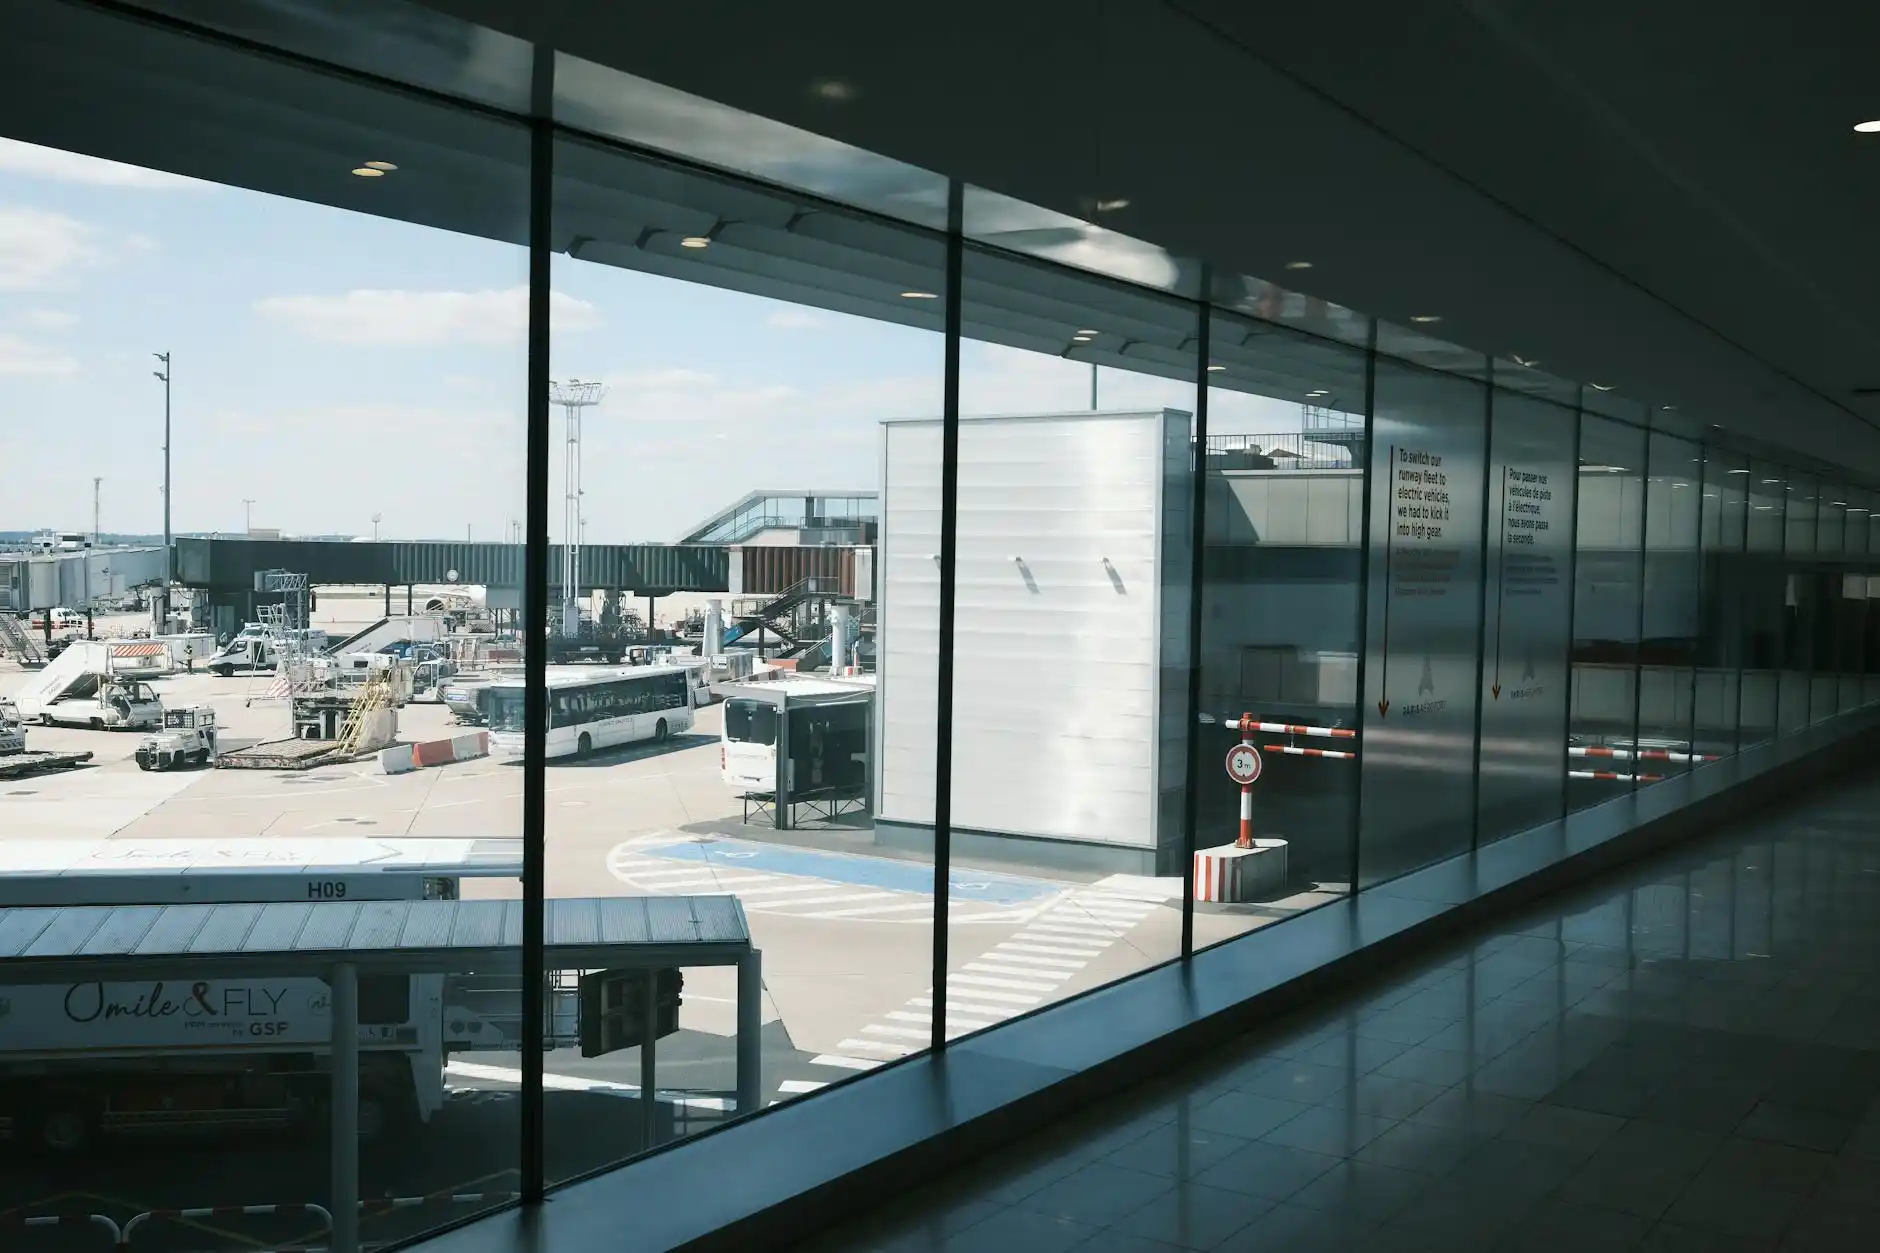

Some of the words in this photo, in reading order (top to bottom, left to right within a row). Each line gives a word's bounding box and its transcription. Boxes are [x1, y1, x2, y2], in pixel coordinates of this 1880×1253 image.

[1399, 448, 1408, 462] To
[1409, 450, 1429, 466] switch
[1431, 456, 1442, 467] our
[1399, 469, 1421, 485] runway
[1424, 469, 1438, 484] fleet
[1440, 473, 1446, 485] to
[1509, 468, 1521, 481] Pour
[1398, 486, 1422, 501] electric
[1424, 488, 1449, 506] vehicles,
[1533, 487, 1539, 499] de
[1398, 505, 1407, 517] we
[1409, 504, 1420, 518] had
[1422, 506, 1429, 519] to
[1431, 506, 1442, 520] kick
[1445, 506, 1449, 520] it
[1397, 522, 1410, 536] into
[1412, 522, 1425, 539] high
[1427, 527, 1442, 540] gear.
[308, 882, 346, 898] H09
[224, 988, 287, 1017] FLY
[250, 1022, 289, 1036] GSF
